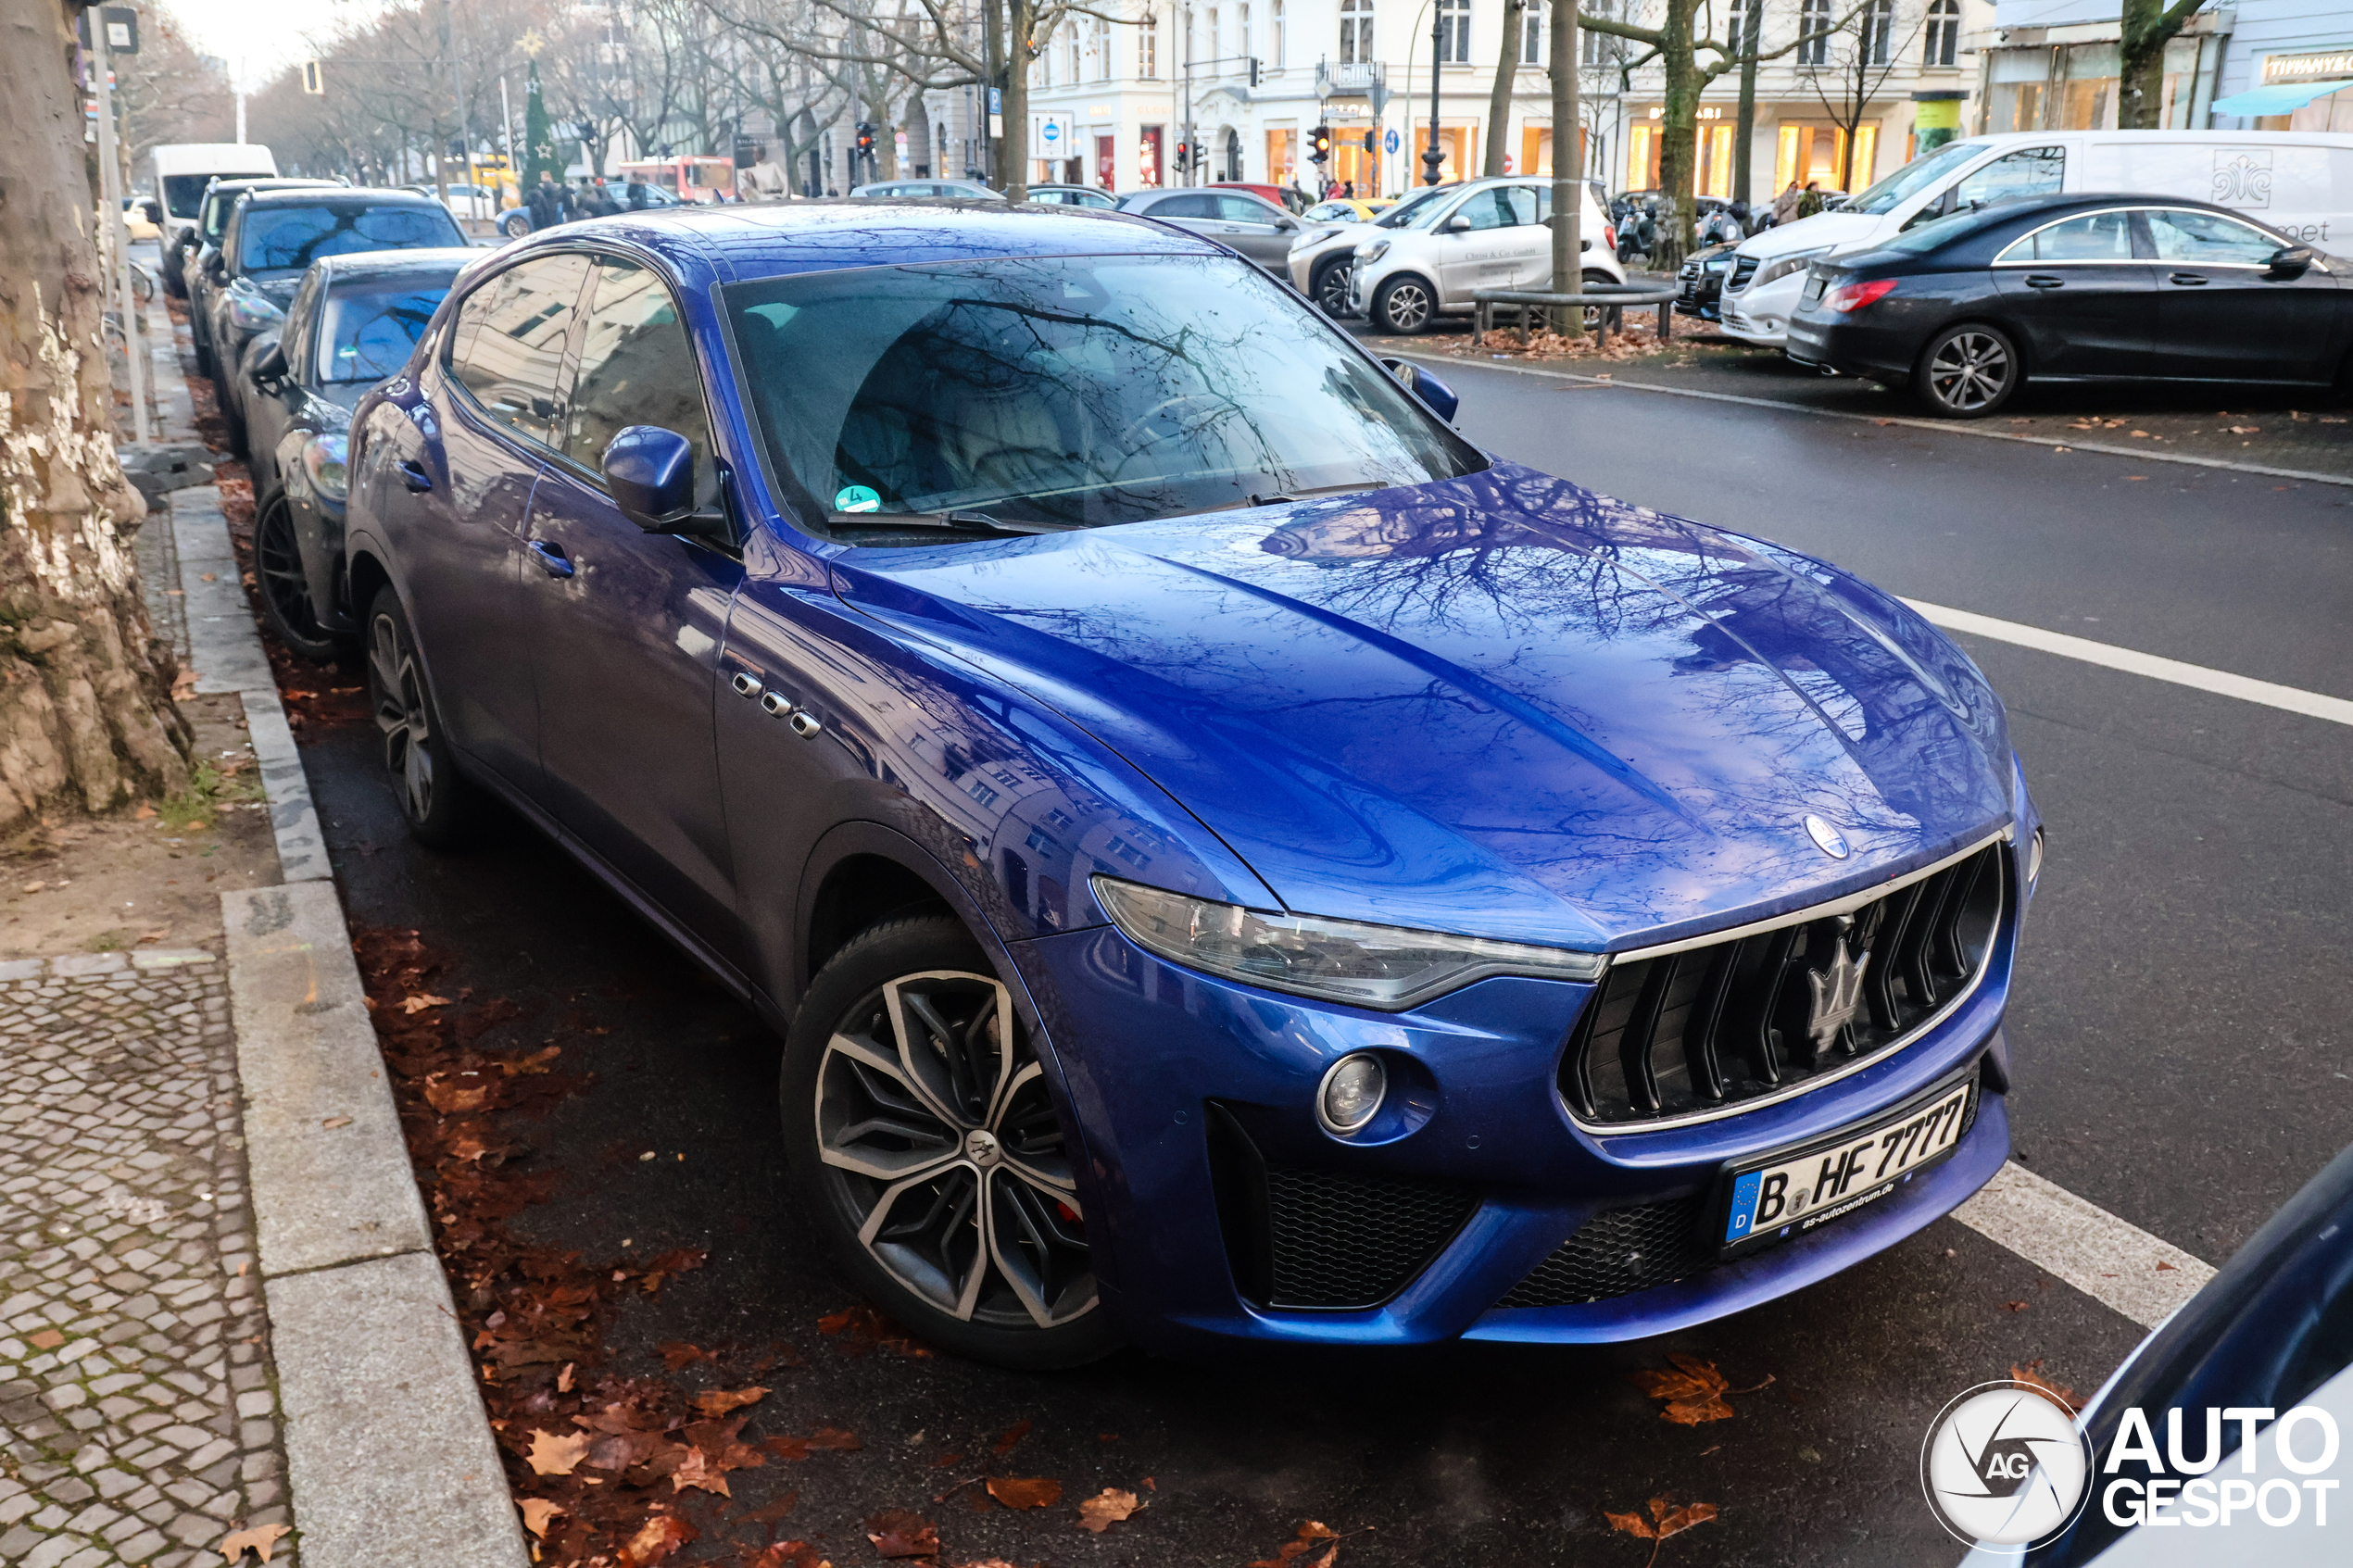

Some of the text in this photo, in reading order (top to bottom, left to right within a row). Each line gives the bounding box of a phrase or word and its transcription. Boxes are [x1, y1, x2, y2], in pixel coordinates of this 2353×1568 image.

[850, 488, 862, 501] 4
[1735, 1094, 1963, 1229] D B HF 7777
[1802, 1183, 1894, 1229] as-autozentrum.de
